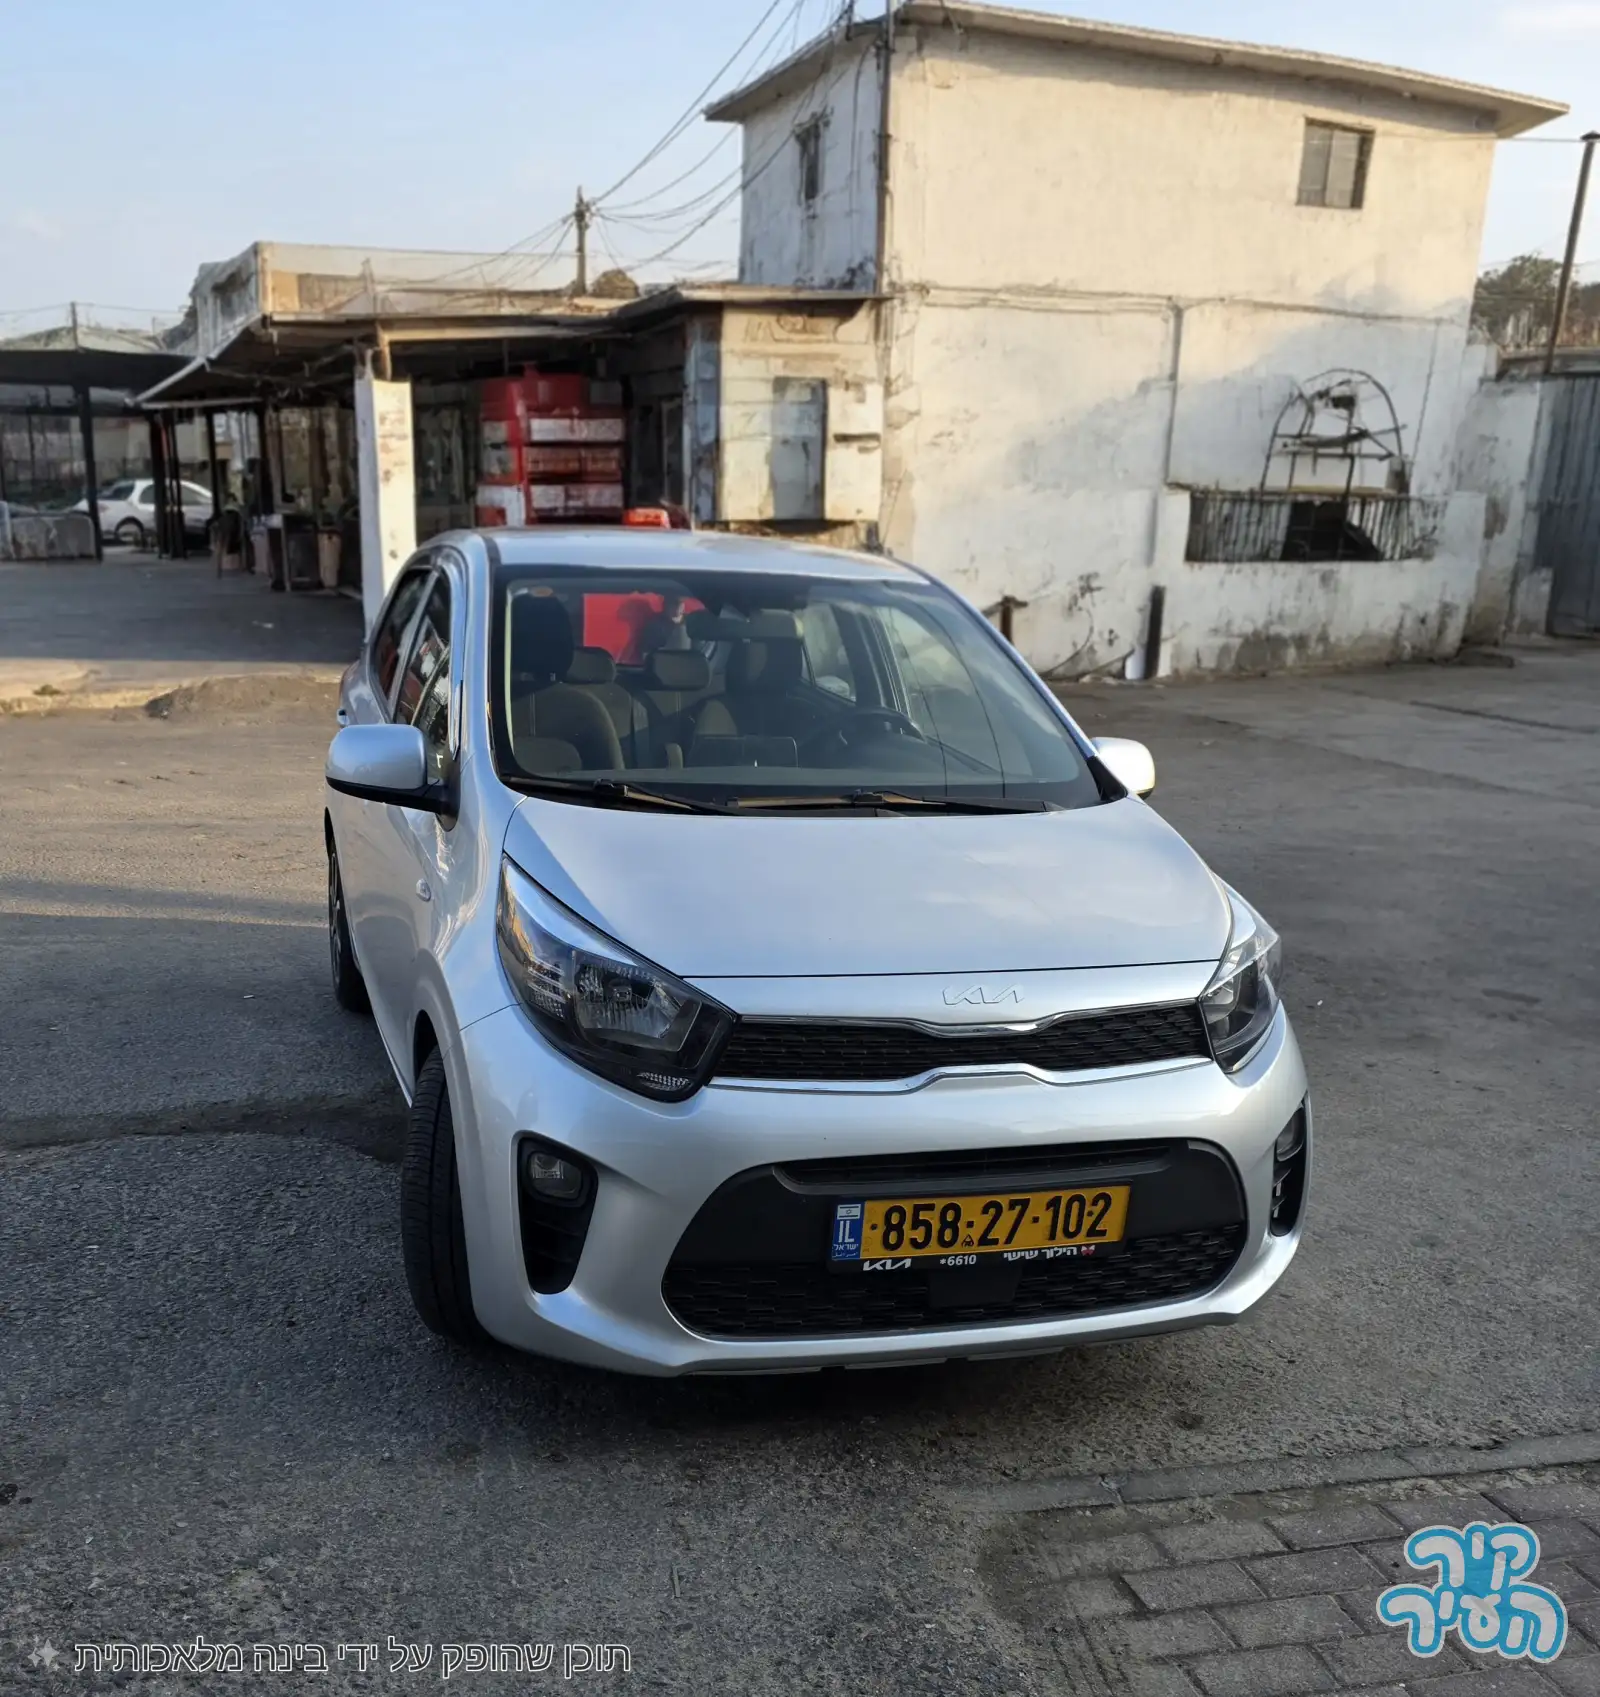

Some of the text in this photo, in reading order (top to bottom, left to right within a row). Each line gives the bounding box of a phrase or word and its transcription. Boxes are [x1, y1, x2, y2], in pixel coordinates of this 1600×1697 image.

[942, 984, 1025, 1006] KIA
[838, 1220, 854, 1243] IL
[1003, 1246, 1077, 1262] הילוך שישי
[863, 1258, 912, 1271] KIA
